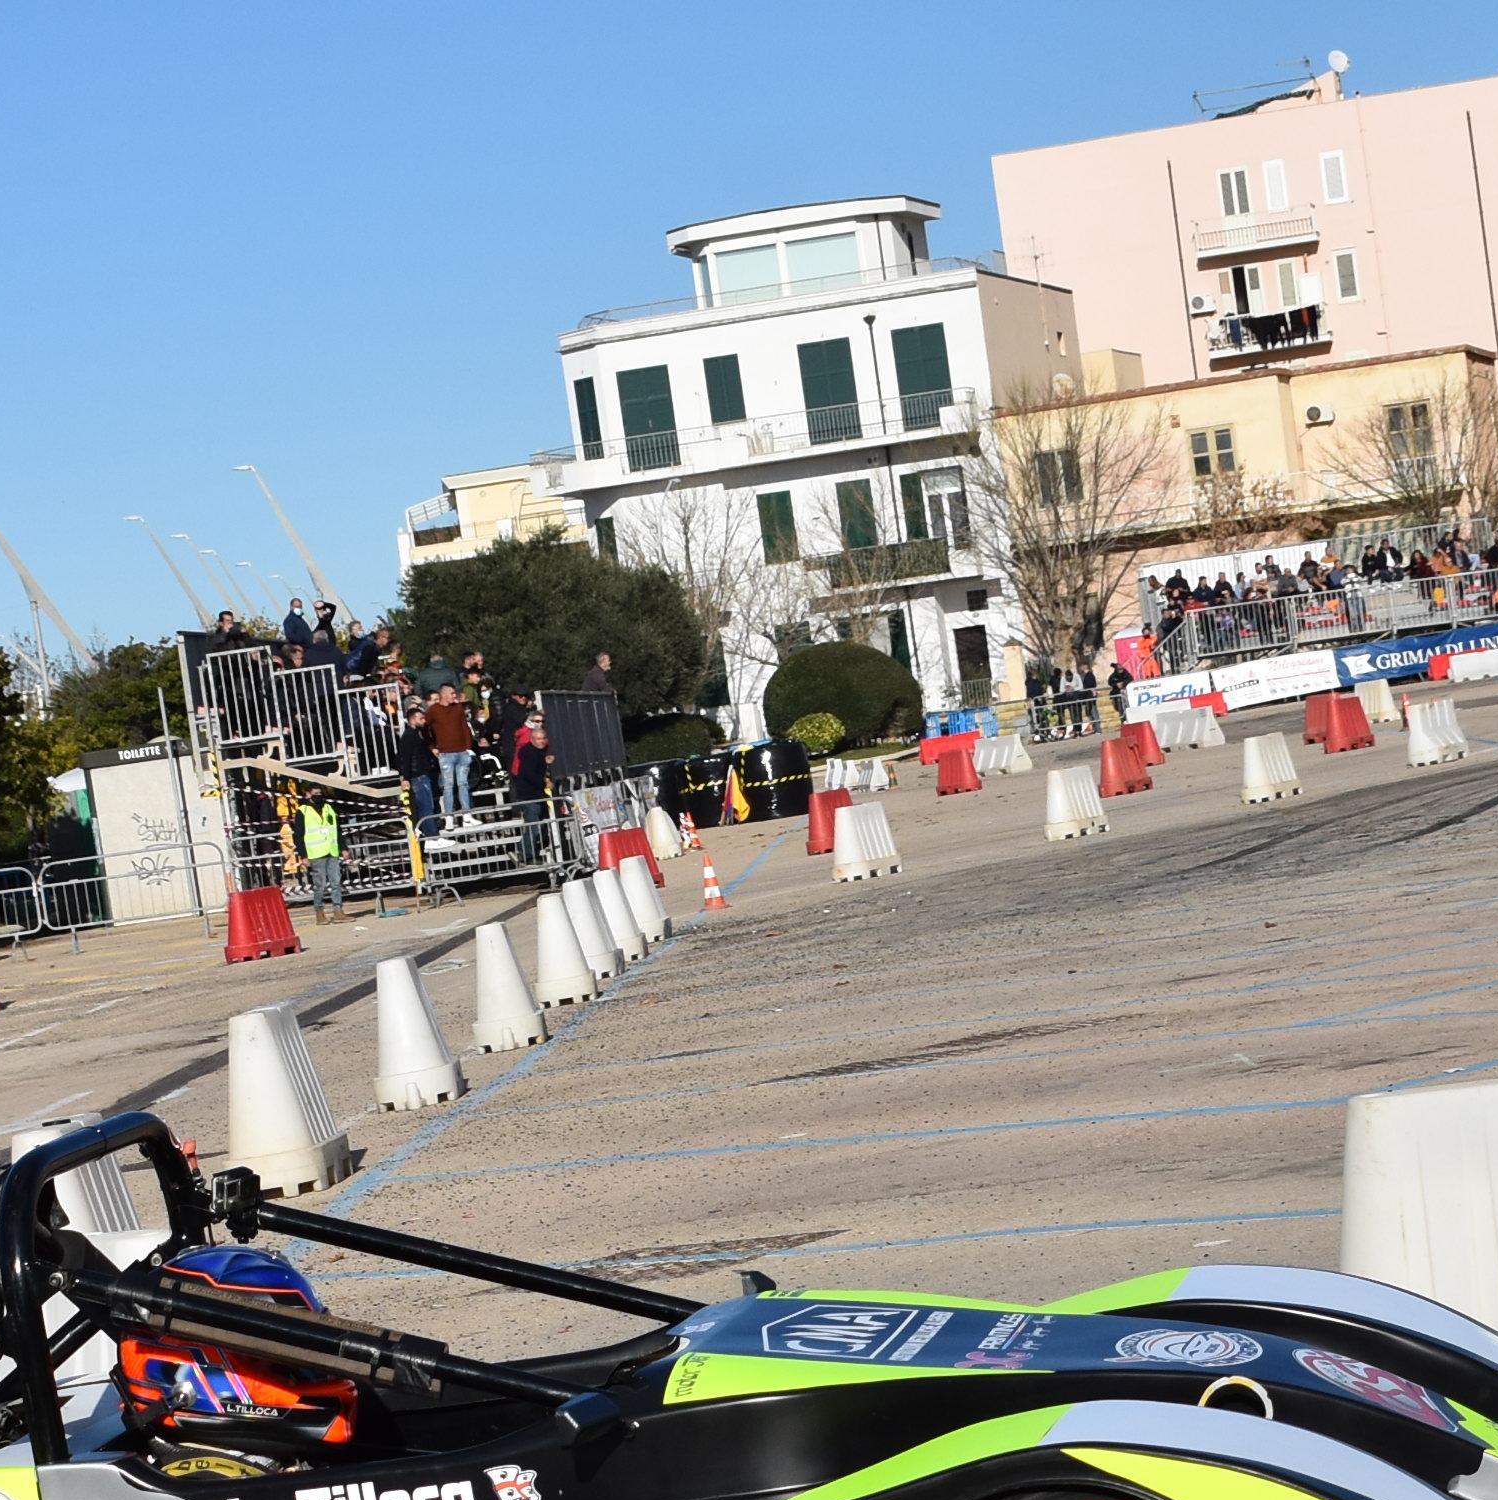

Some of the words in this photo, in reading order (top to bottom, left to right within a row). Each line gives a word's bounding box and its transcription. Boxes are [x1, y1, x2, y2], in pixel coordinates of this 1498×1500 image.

[1376, 640, 1463, 670] GRIMALDI
[118, 745, 161, 760] TOILETTE
[226, 1403, 279, 1417] L.TILLOCA
